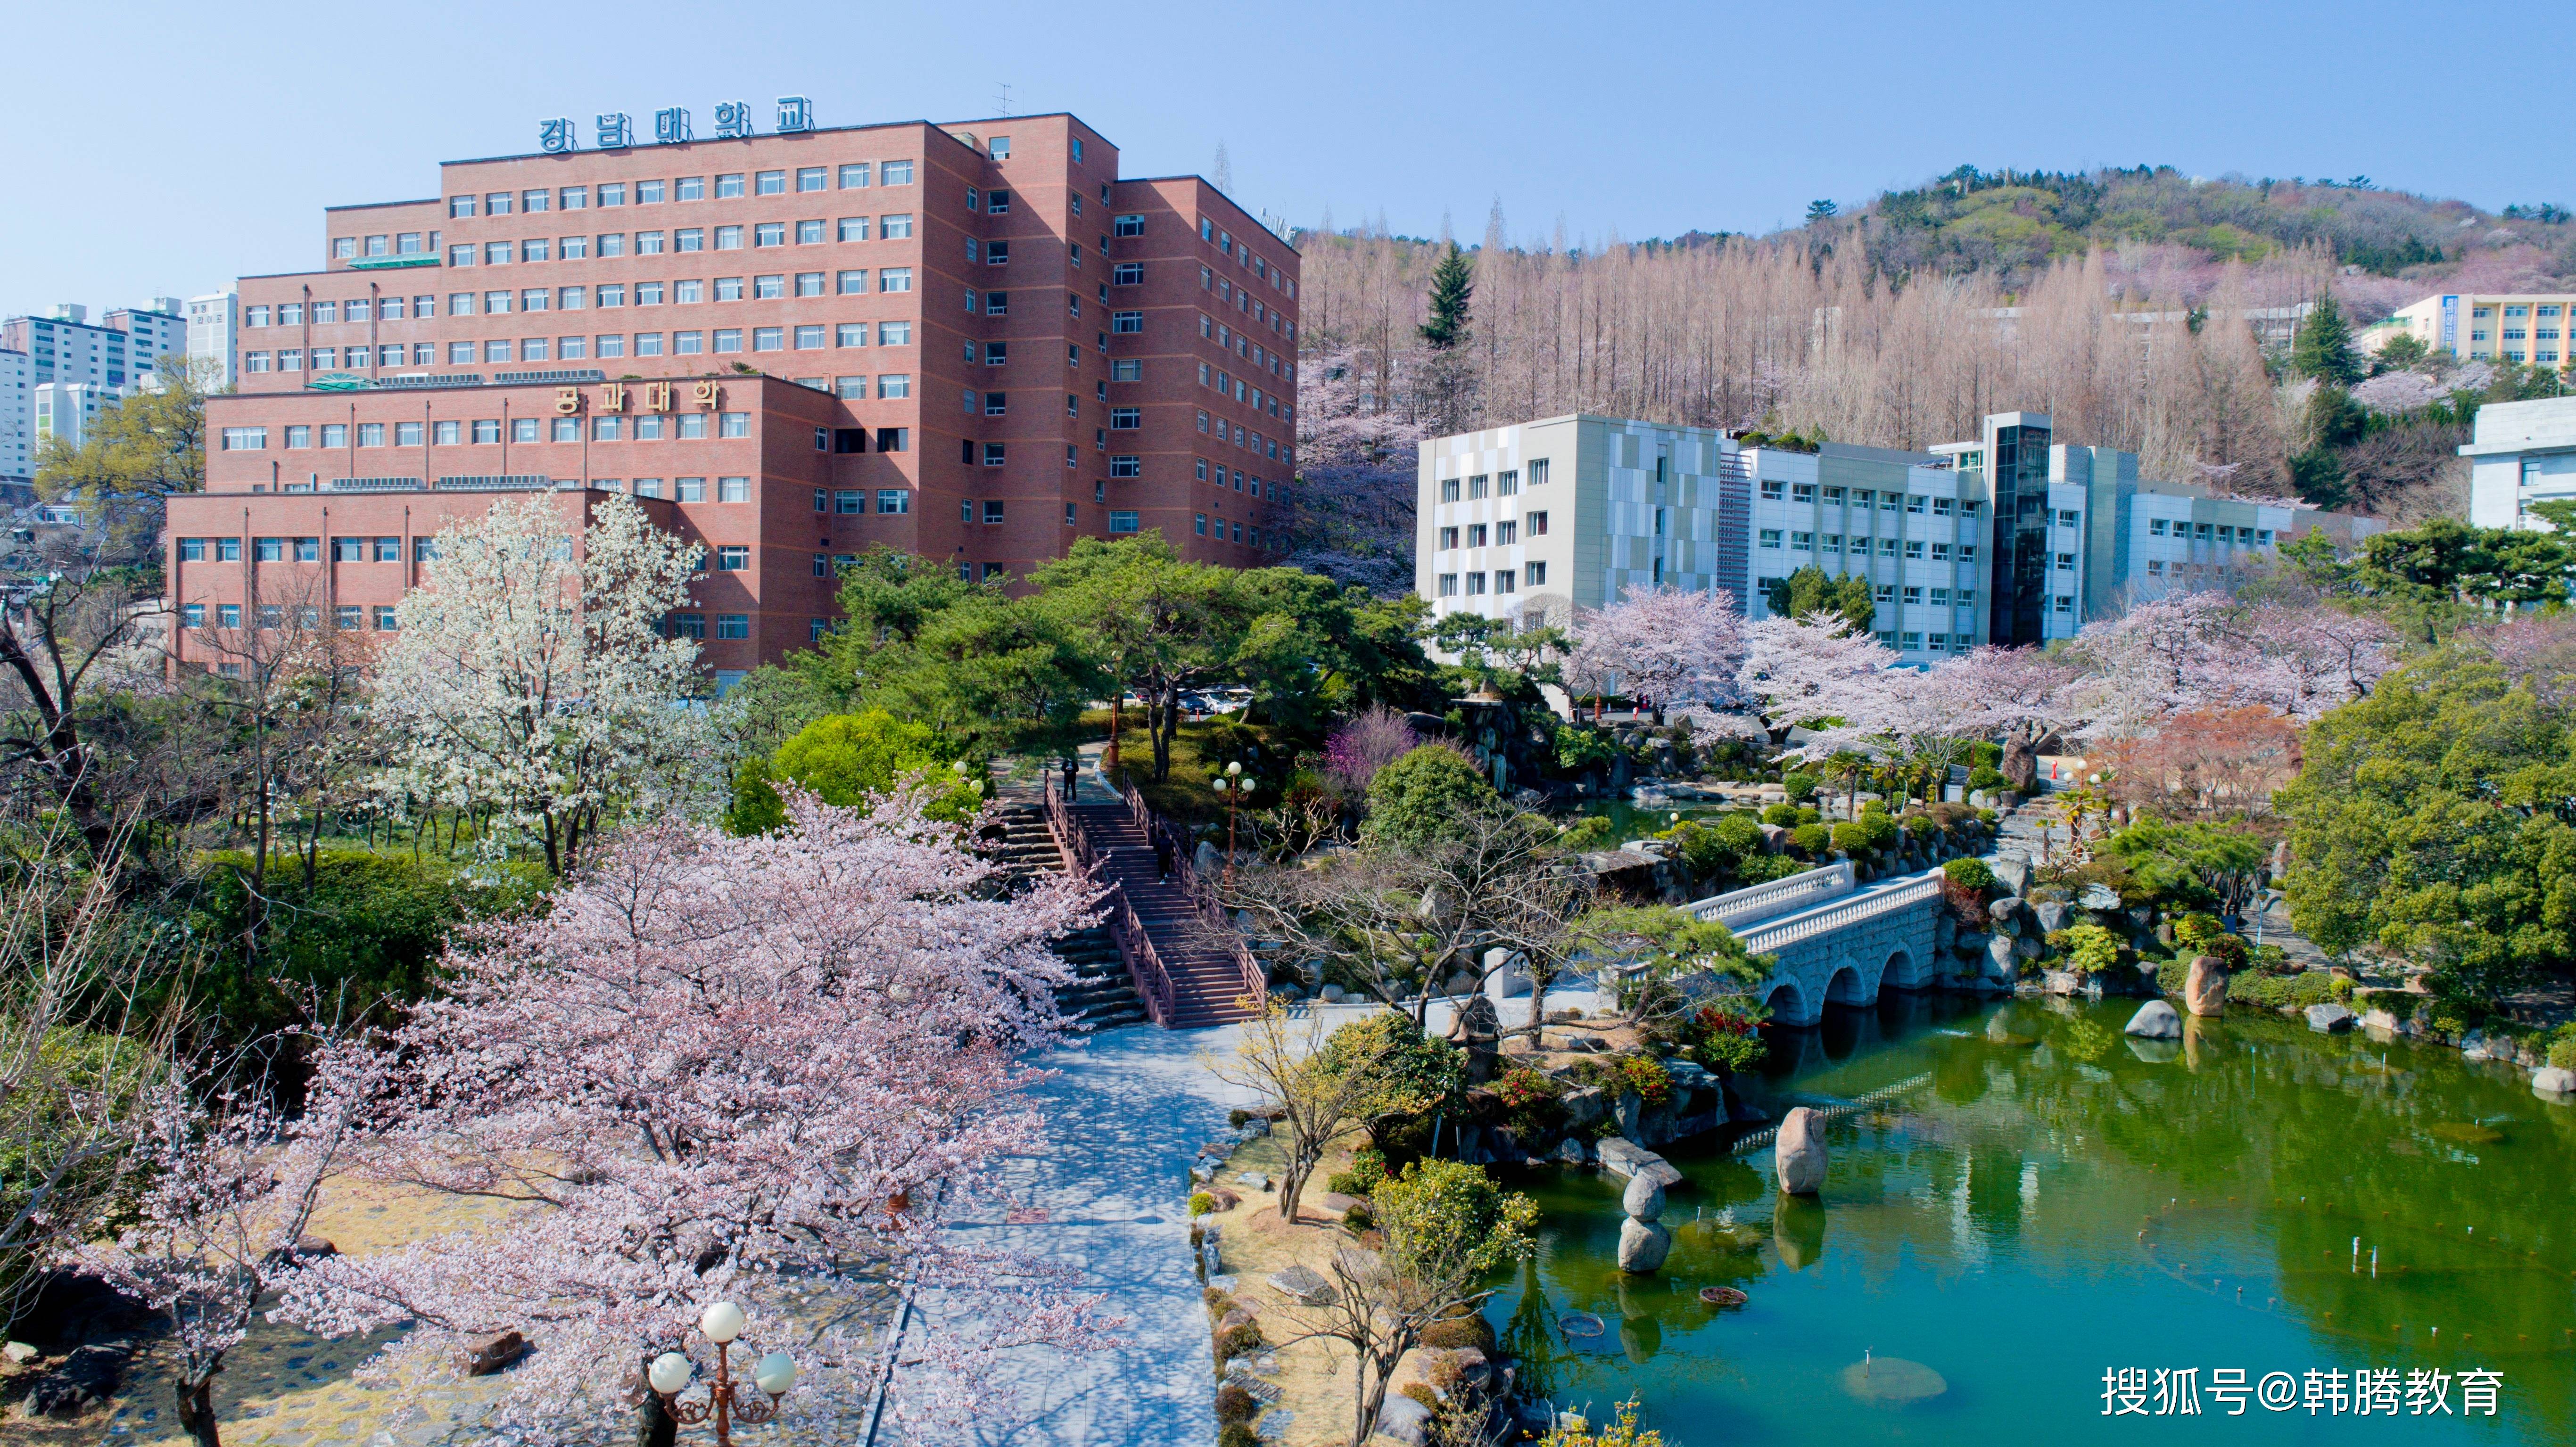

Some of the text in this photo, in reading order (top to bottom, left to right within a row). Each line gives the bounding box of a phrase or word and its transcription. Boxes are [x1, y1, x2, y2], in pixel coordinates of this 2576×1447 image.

[539, 95, 806, 154] 경남대학교
[198, 314, 223, 324] 라이프
[555, 380, 719, 413] 공과대학
